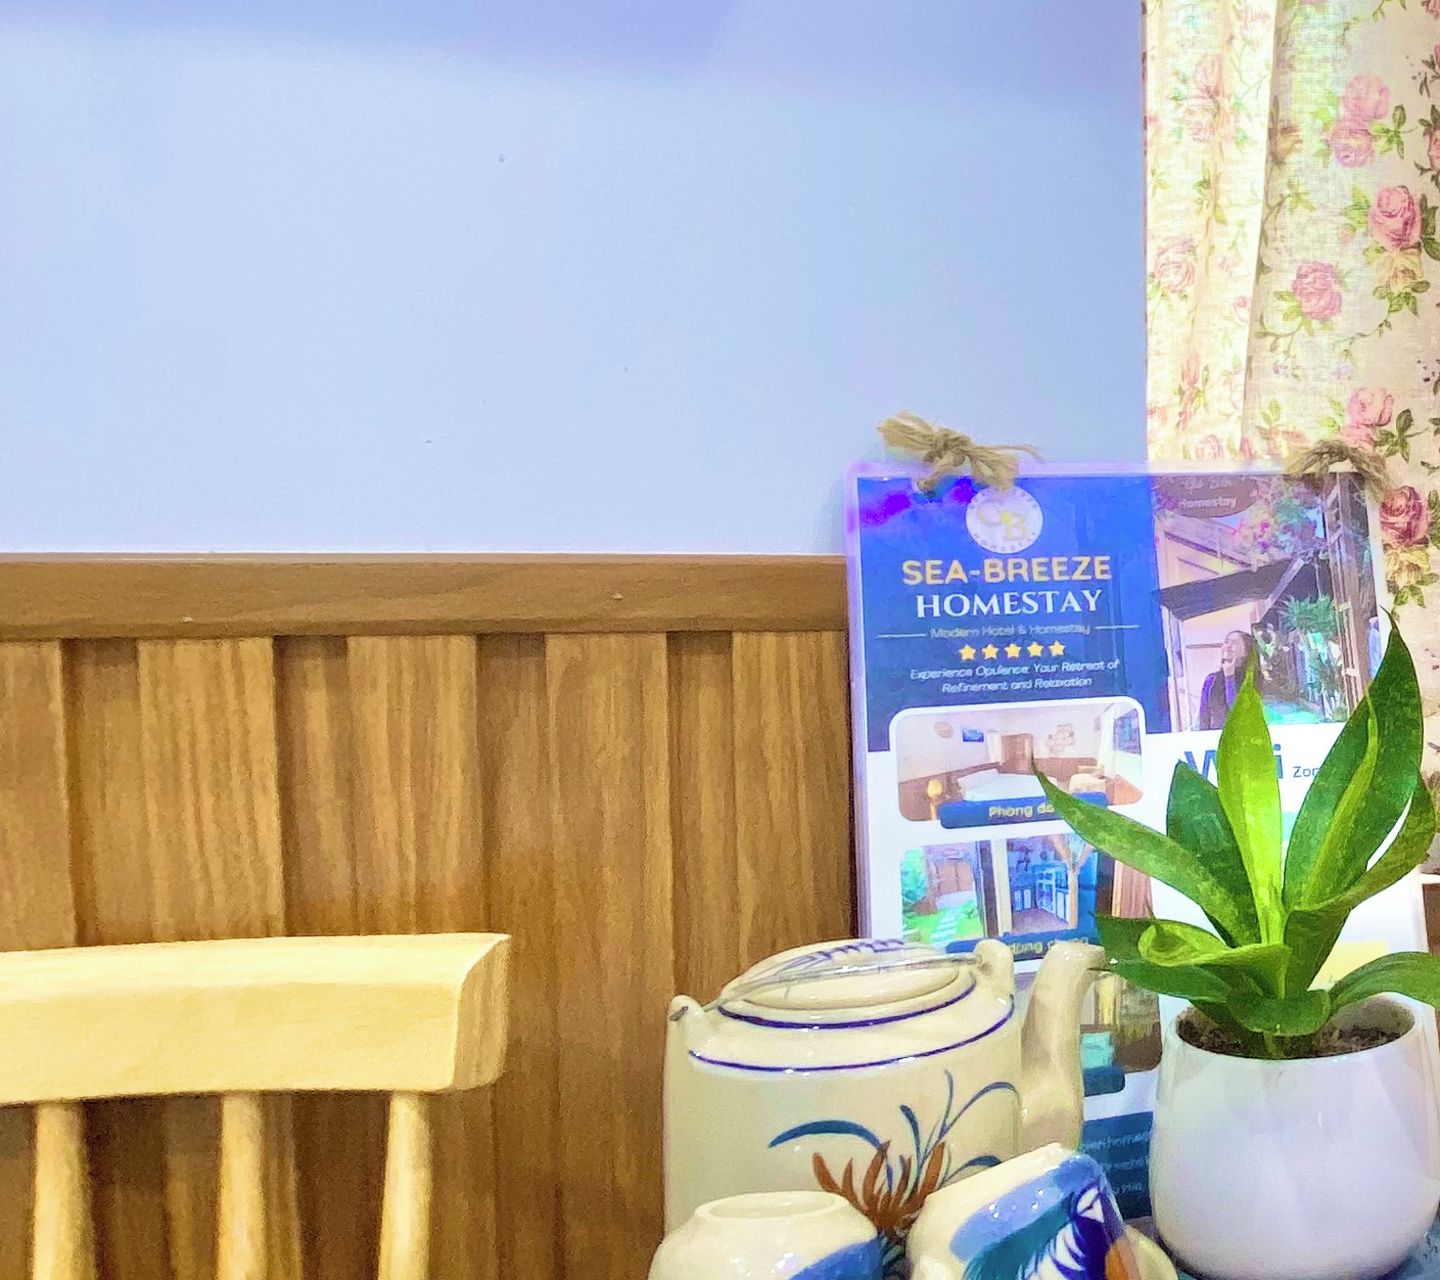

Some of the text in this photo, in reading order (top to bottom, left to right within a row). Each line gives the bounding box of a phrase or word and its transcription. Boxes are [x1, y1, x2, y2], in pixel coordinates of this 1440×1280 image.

[902, 555, 1113, 586] SEA-BREEZE
[916, 589, 1103, 618] HOMESTAY
[910, 666, 973, 681] Experience
[1033, 662, 1058, 674] Your
[1062, 660, 1106, 673] Retreat
[1108, 658, 1120, 670] of
[942, 677, 1092, 694] Refinement and Relaxation
